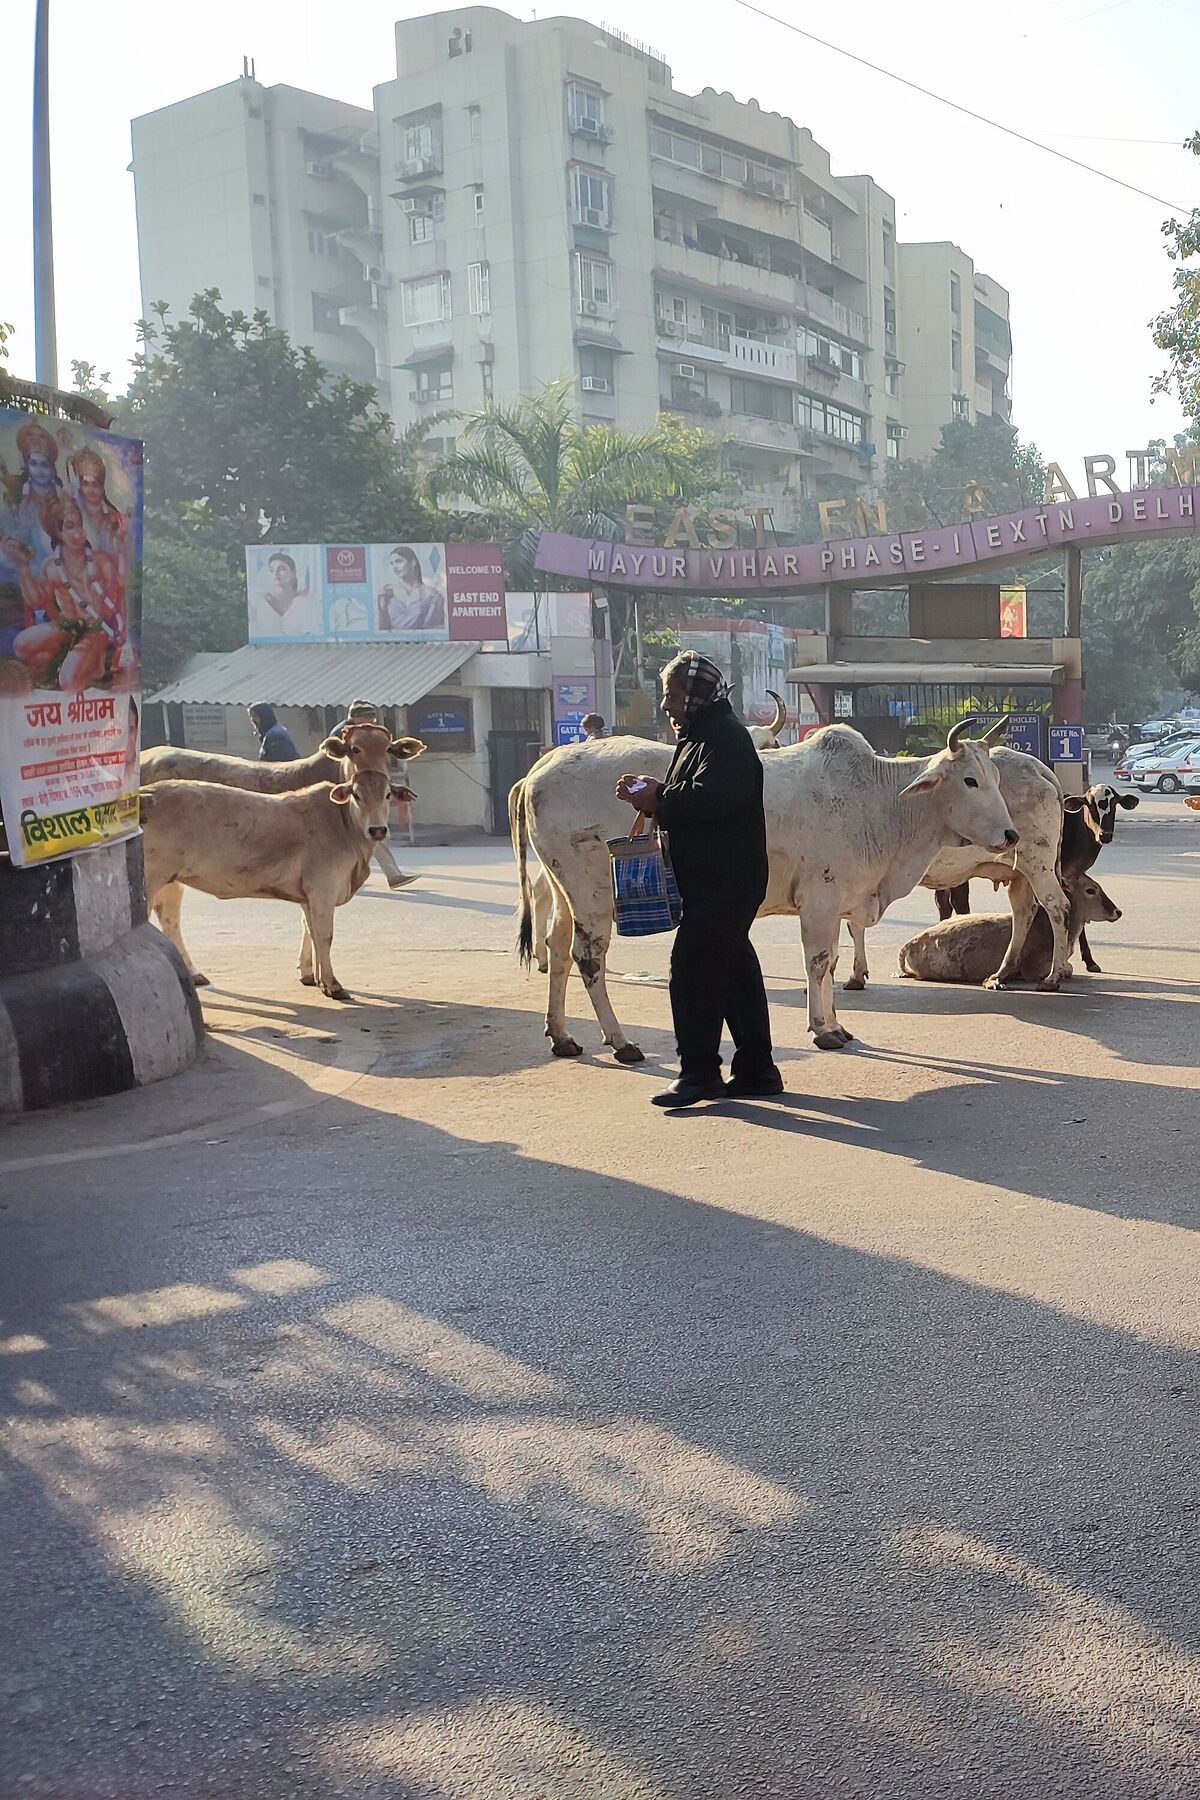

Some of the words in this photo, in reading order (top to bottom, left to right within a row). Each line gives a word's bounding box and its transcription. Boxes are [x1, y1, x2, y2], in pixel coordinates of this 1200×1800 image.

[625, 504, 779, 549] EAST
[588, 549, 687, 578] MAYUR
[709, 553, 799, 579] VIHAR
[986, 509, 1091, 549] EXTN.
[449, 566, 489, 575] WELCOME
[490, 565, 502, 574] TO
[453, 592, 479, 603] EAST
[480, 592, 499, 602] END
[452, 606, 502, 617] APARTMENT
[24, 703, 62, 727] जय
[1008, 716, 1037, 724] EHICLES
[560, 726, 578, 735] GATE
[1051, 729, 1067, 737] GATE
[1025, 742, 1032, 751] 2
[1060, 738, 1074, 758] 1
[21, 808, 92, 846] विशाल
